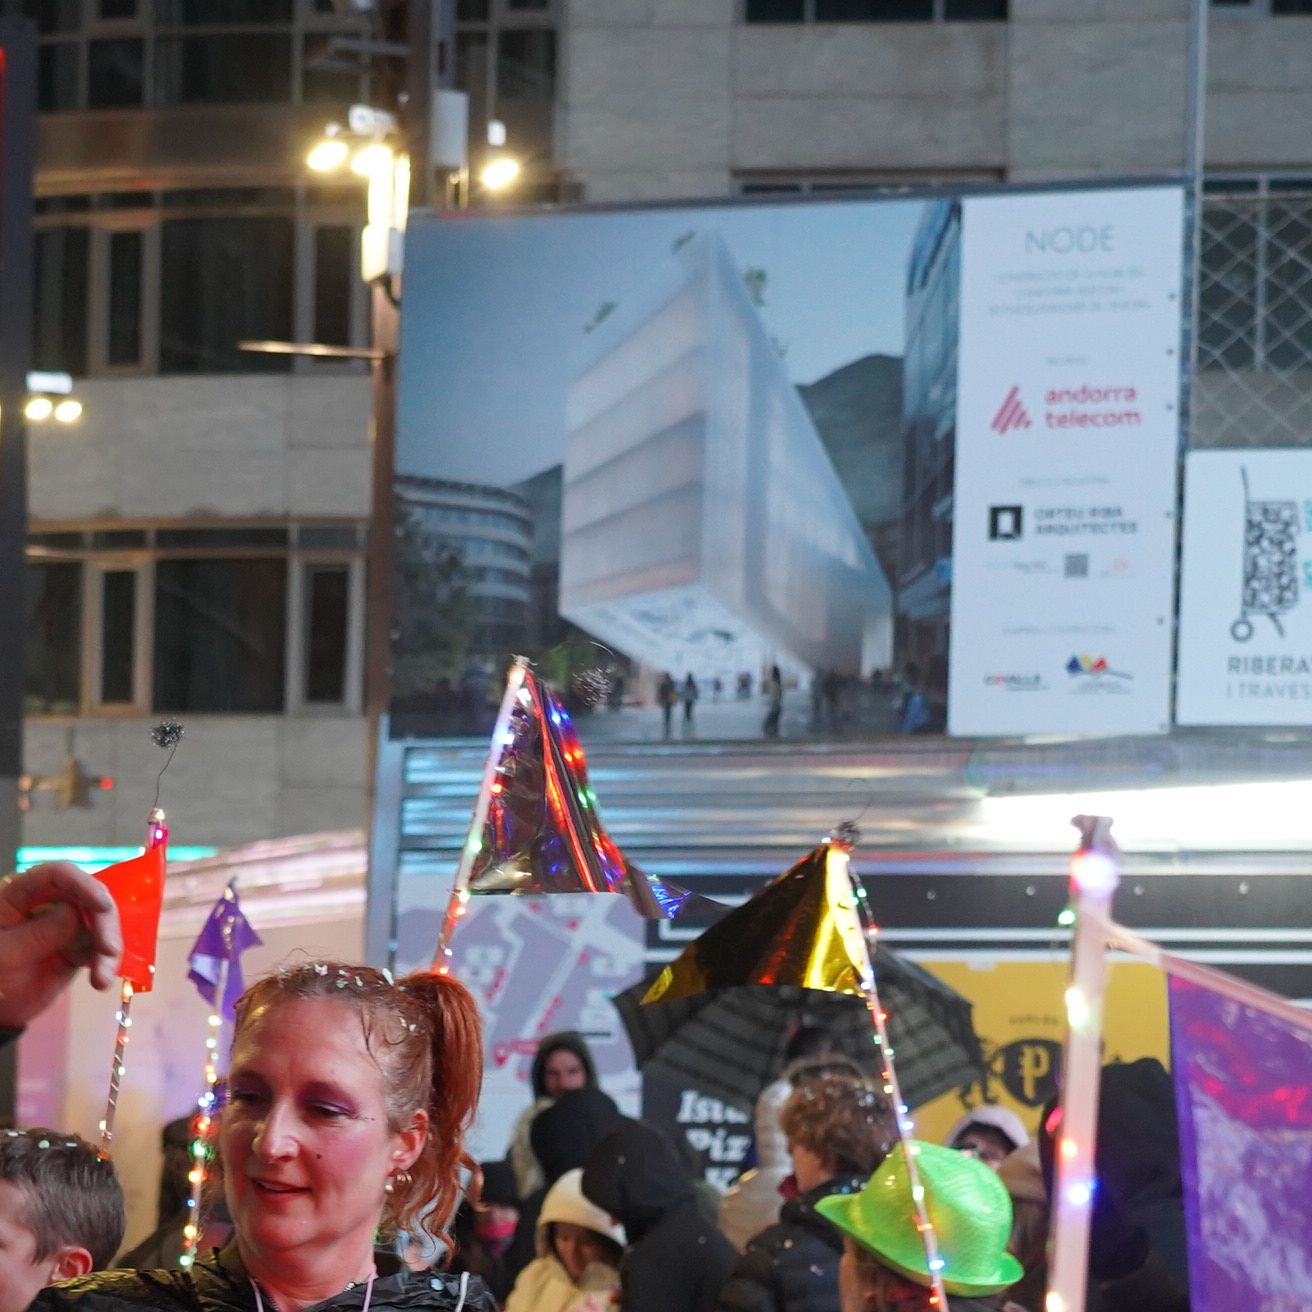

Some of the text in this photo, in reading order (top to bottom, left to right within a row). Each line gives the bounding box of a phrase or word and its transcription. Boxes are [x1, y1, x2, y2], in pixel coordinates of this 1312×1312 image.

[1024, 225, 1116, 254] NODE
[1044, 384, 1138, 403] andorra
[1044, 411, 1143, 429] telecom
